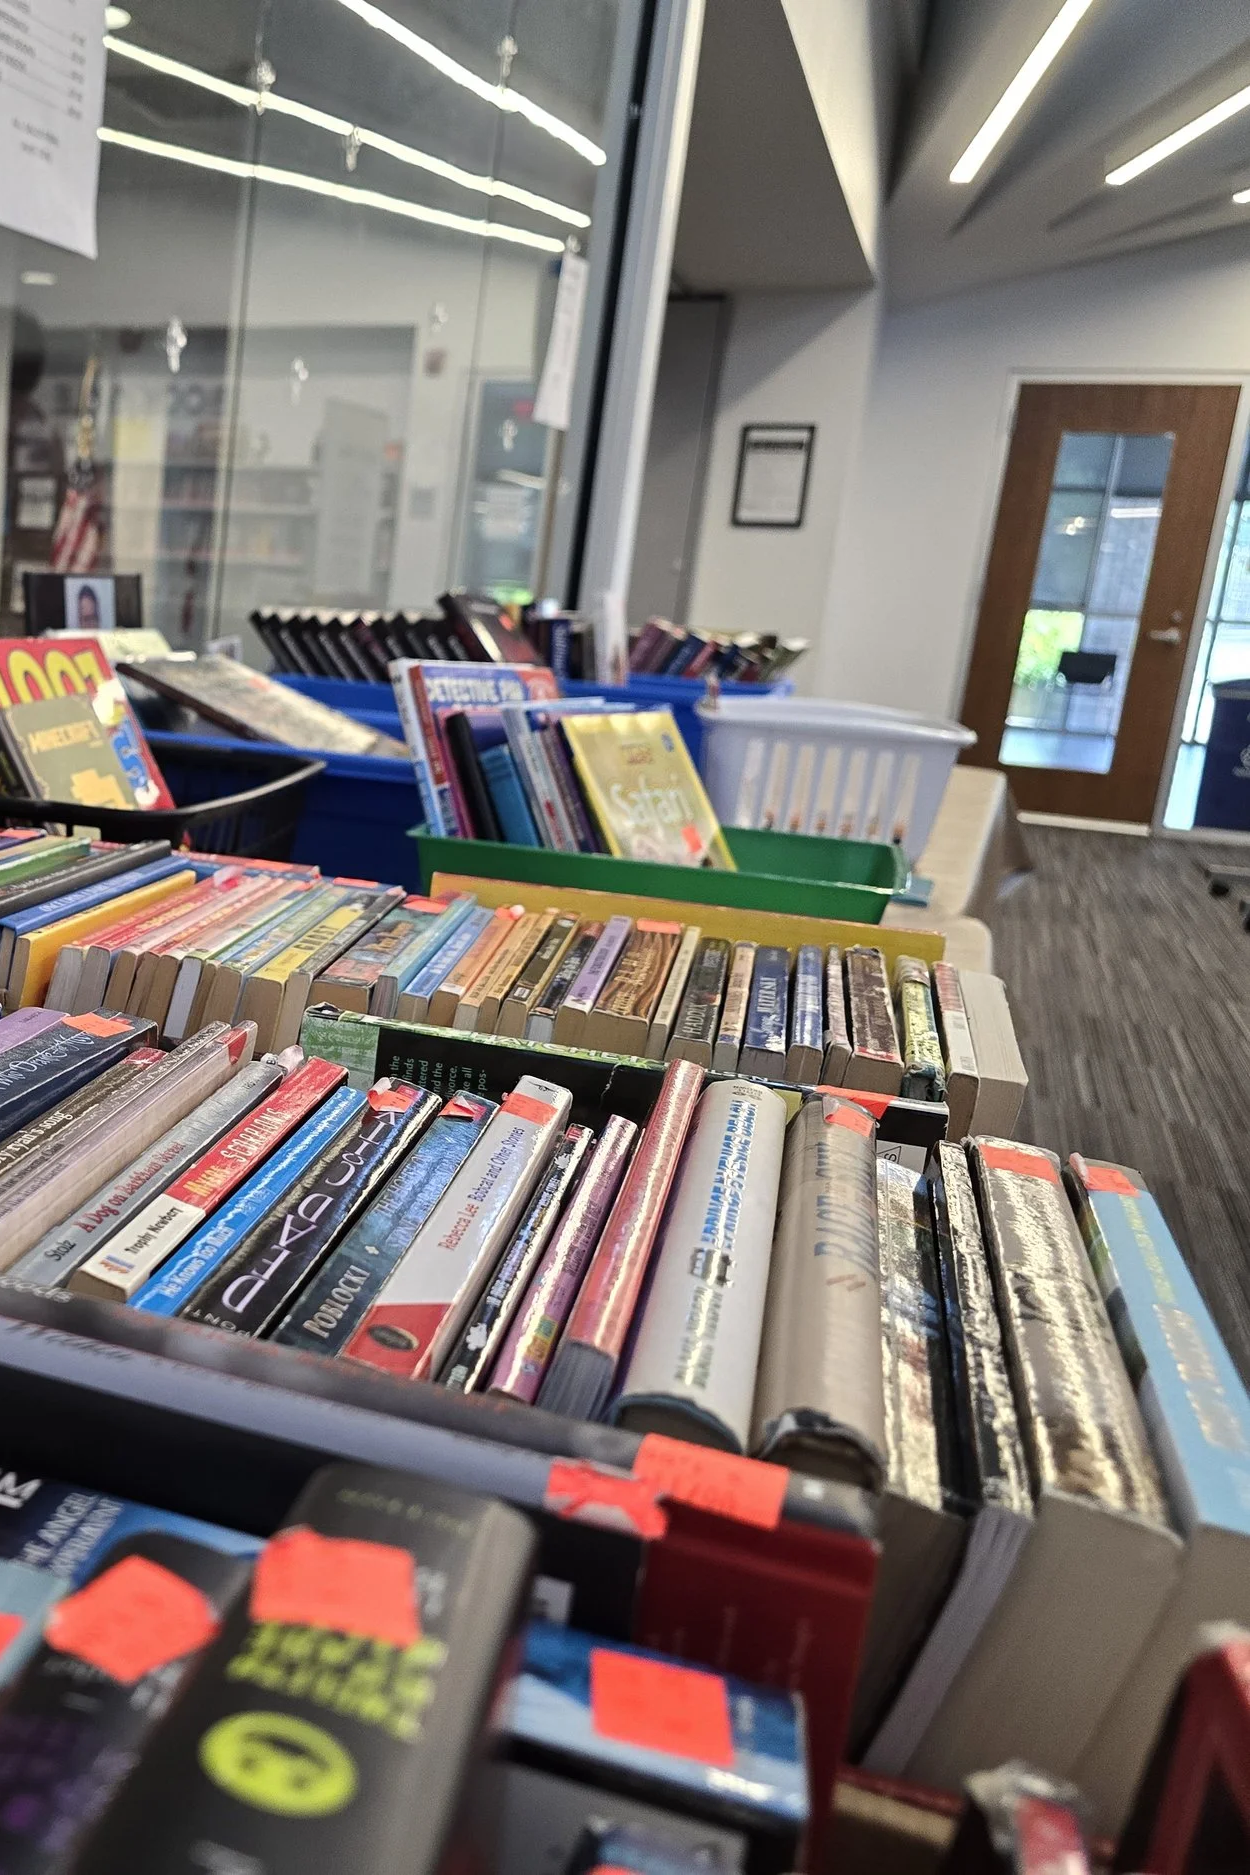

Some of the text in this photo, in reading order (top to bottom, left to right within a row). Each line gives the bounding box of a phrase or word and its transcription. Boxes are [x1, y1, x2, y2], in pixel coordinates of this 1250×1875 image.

[682, 1001, 709, 1036] HADDIX
[388, 1055, 401, 1072] the
[402, 1057, 415, 1082] finds
[435, 1061, 445, 1078] the
[6, 1123, 45, 1151] ryan's
[43, 1109, 75, 1137] song
[220, 1106, 293, 1164] SCORPIONS
[504, 1125, 527, 1153] Stories
[489, 1140, 512, 1169] Other
[467, 1171, 495, 1209] Bobcat
[91, 1202, 121, 1226] Dog
[108, 1191, 128, 1208] on
[464, 1201, 481, 1220] Lee
[123, 1225, 157, 1258] Trophy
[437, 1208, 471, 1252] Rebecca
[43, 1239, 77, 1262] Stolz
[221, 1192, 334, 1315] DEAD
[172, 1256, 204, 1287] Knows
[302, 1264, 372, 1340] POBLOCKI
